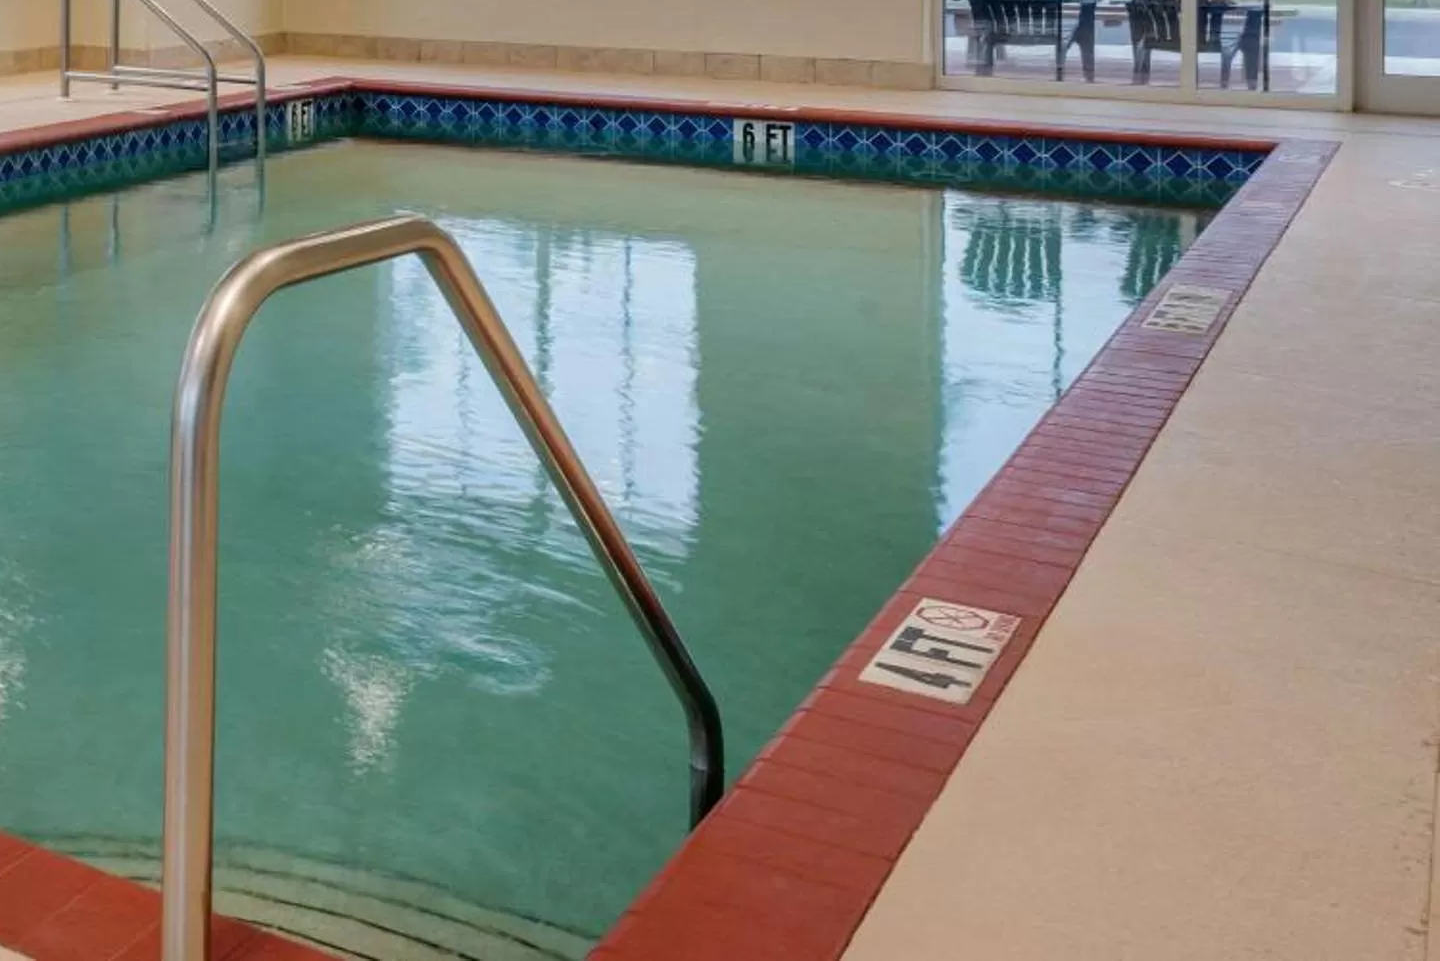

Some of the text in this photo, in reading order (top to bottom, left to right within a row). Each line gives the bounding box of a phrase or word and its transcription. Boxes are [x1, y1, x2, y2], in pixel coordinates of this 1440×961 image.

[742, 122, 791, 144] 6 FT
[874, 626, 995, 689] 4 FT
